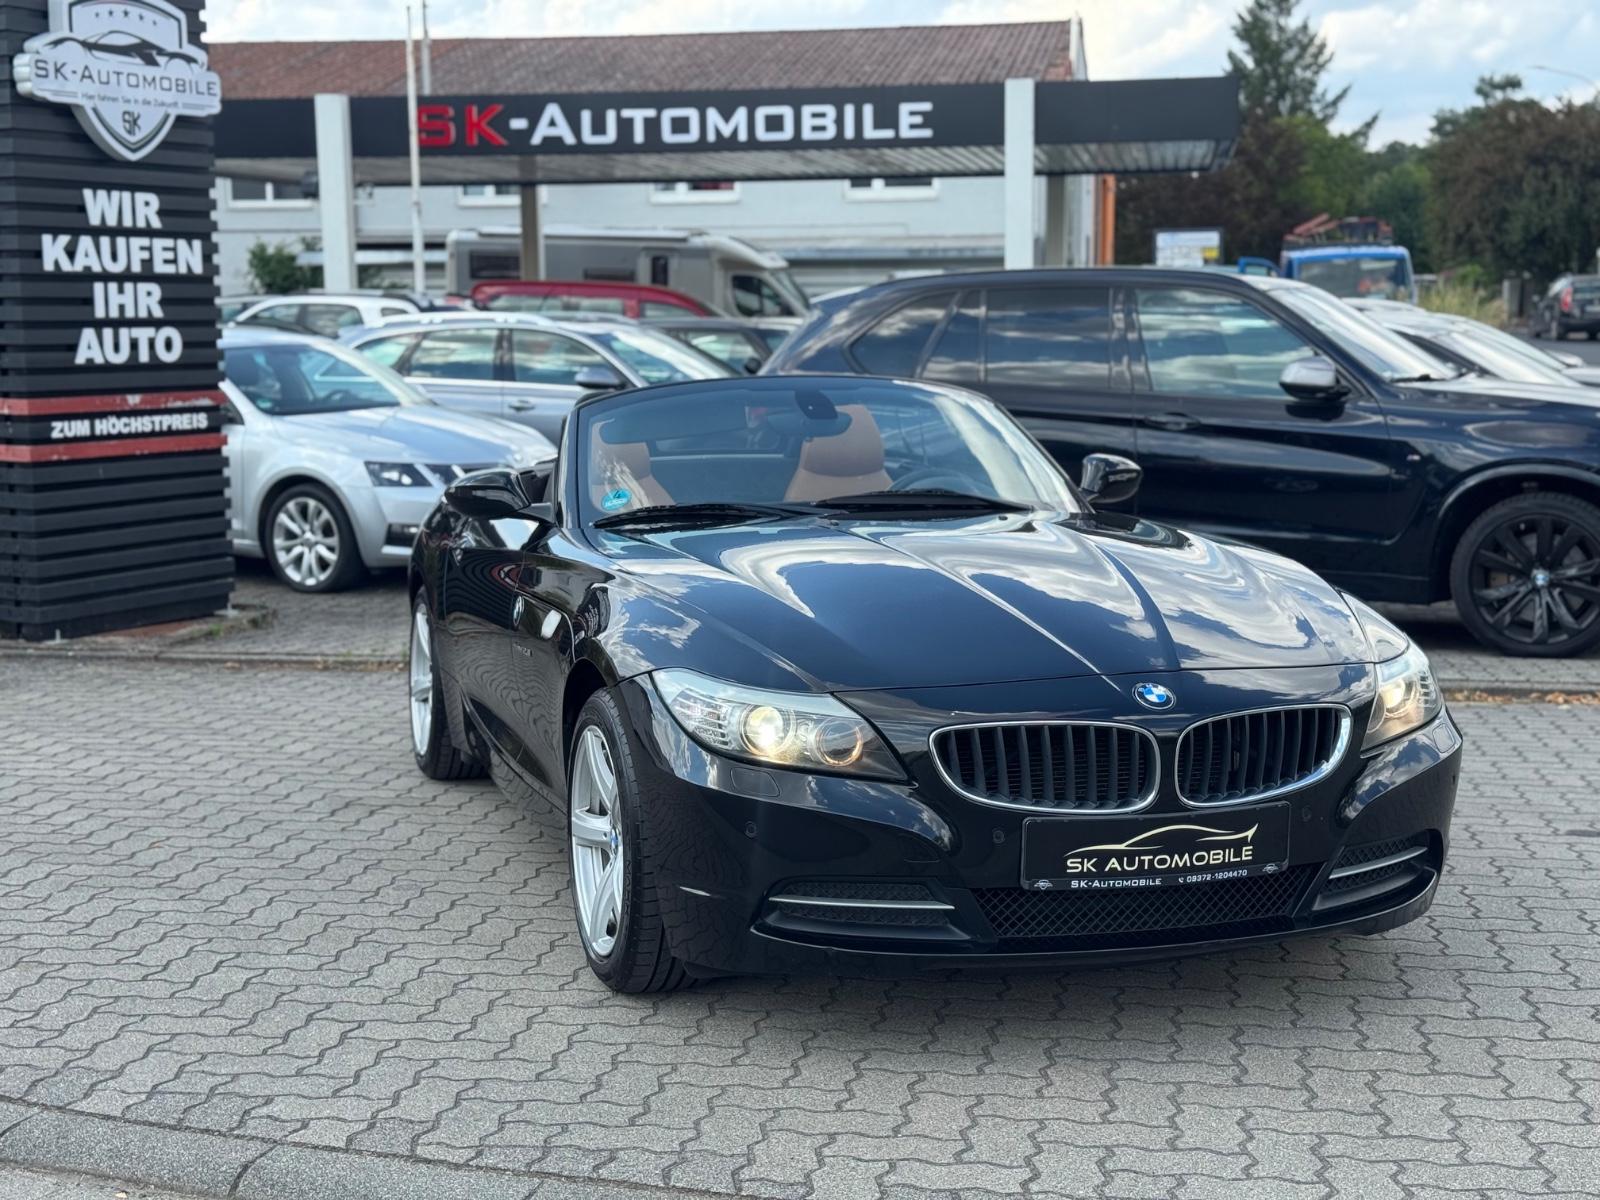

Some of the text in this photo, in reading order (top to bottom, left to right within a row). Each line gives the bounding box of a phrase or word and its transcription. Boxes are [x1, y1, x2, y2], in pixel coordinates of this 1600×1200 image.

[34, 60, 218, 96] SK-AUTOMOBILE
[122, 110, 141, 137] SK
[417, 102, 934, 147] SK-AUTOMOBILE
[83, 188, 162, 229] WIR
[41, 234, 203, 275] KAUFEN
[93, 282, 164, 319] IHR
[74, 326, 183, 365] AUTO
[50, 412, 208, 439] ZUM HÖCHSTPREIS
[1066, 846, 1254, 873] SK AUTOMOBILE
[1071, 869, 1248, 888] SK-AUTOMOBILE 09372-1204470
